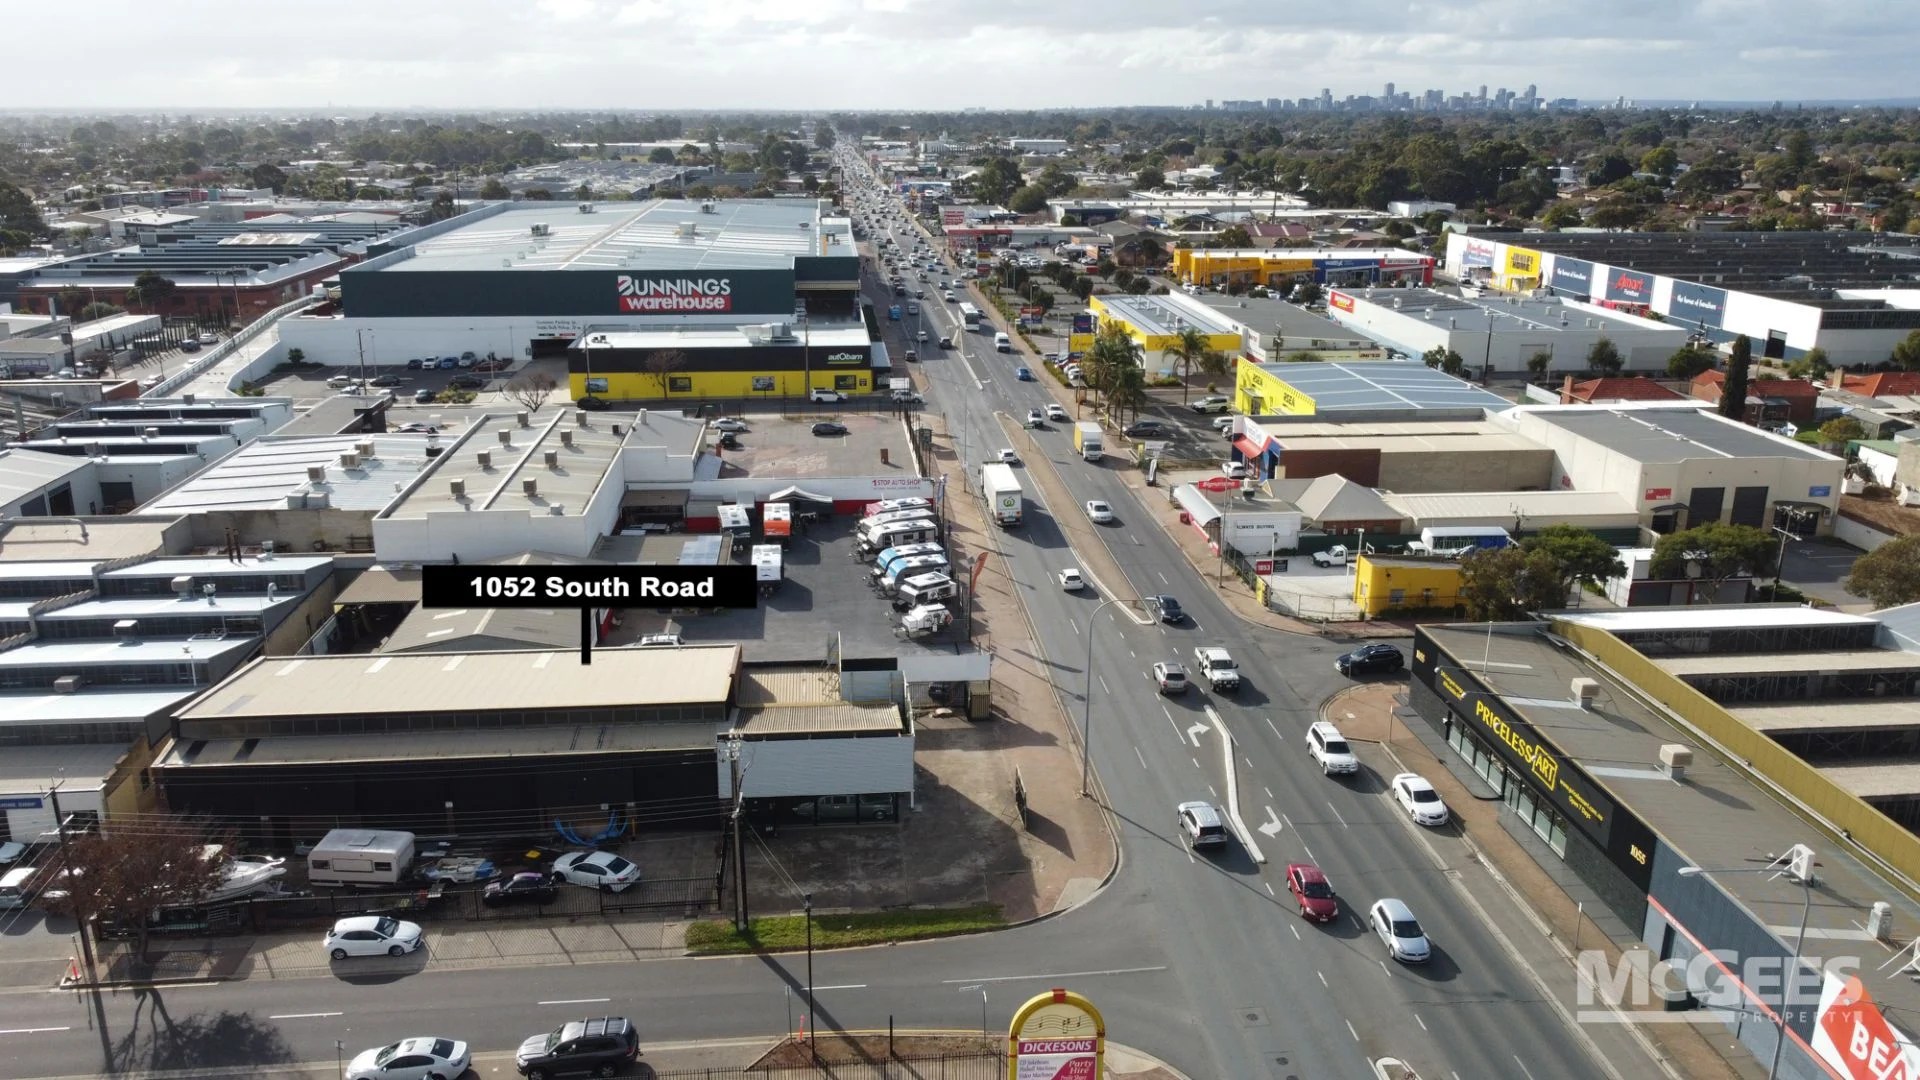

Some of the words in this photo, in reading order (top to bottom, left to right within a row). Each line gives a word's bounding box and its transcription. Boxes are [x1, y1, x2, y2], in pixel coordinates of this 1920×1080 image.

[617, 275, 731, 296] BUNNINGS
[627, 293, 725, 310] warehouse
[1476, 700, 1534, 763] PRICELESS
[1535, 754, 1556, 782] ART
[1630, 844, 1647, 865] 1055
[1023, 1041, 1092, 1053] DICKESONS
[1069, 1060, 1094, 1068] Party
[1069, 1067, 1089, 1075] Hire
